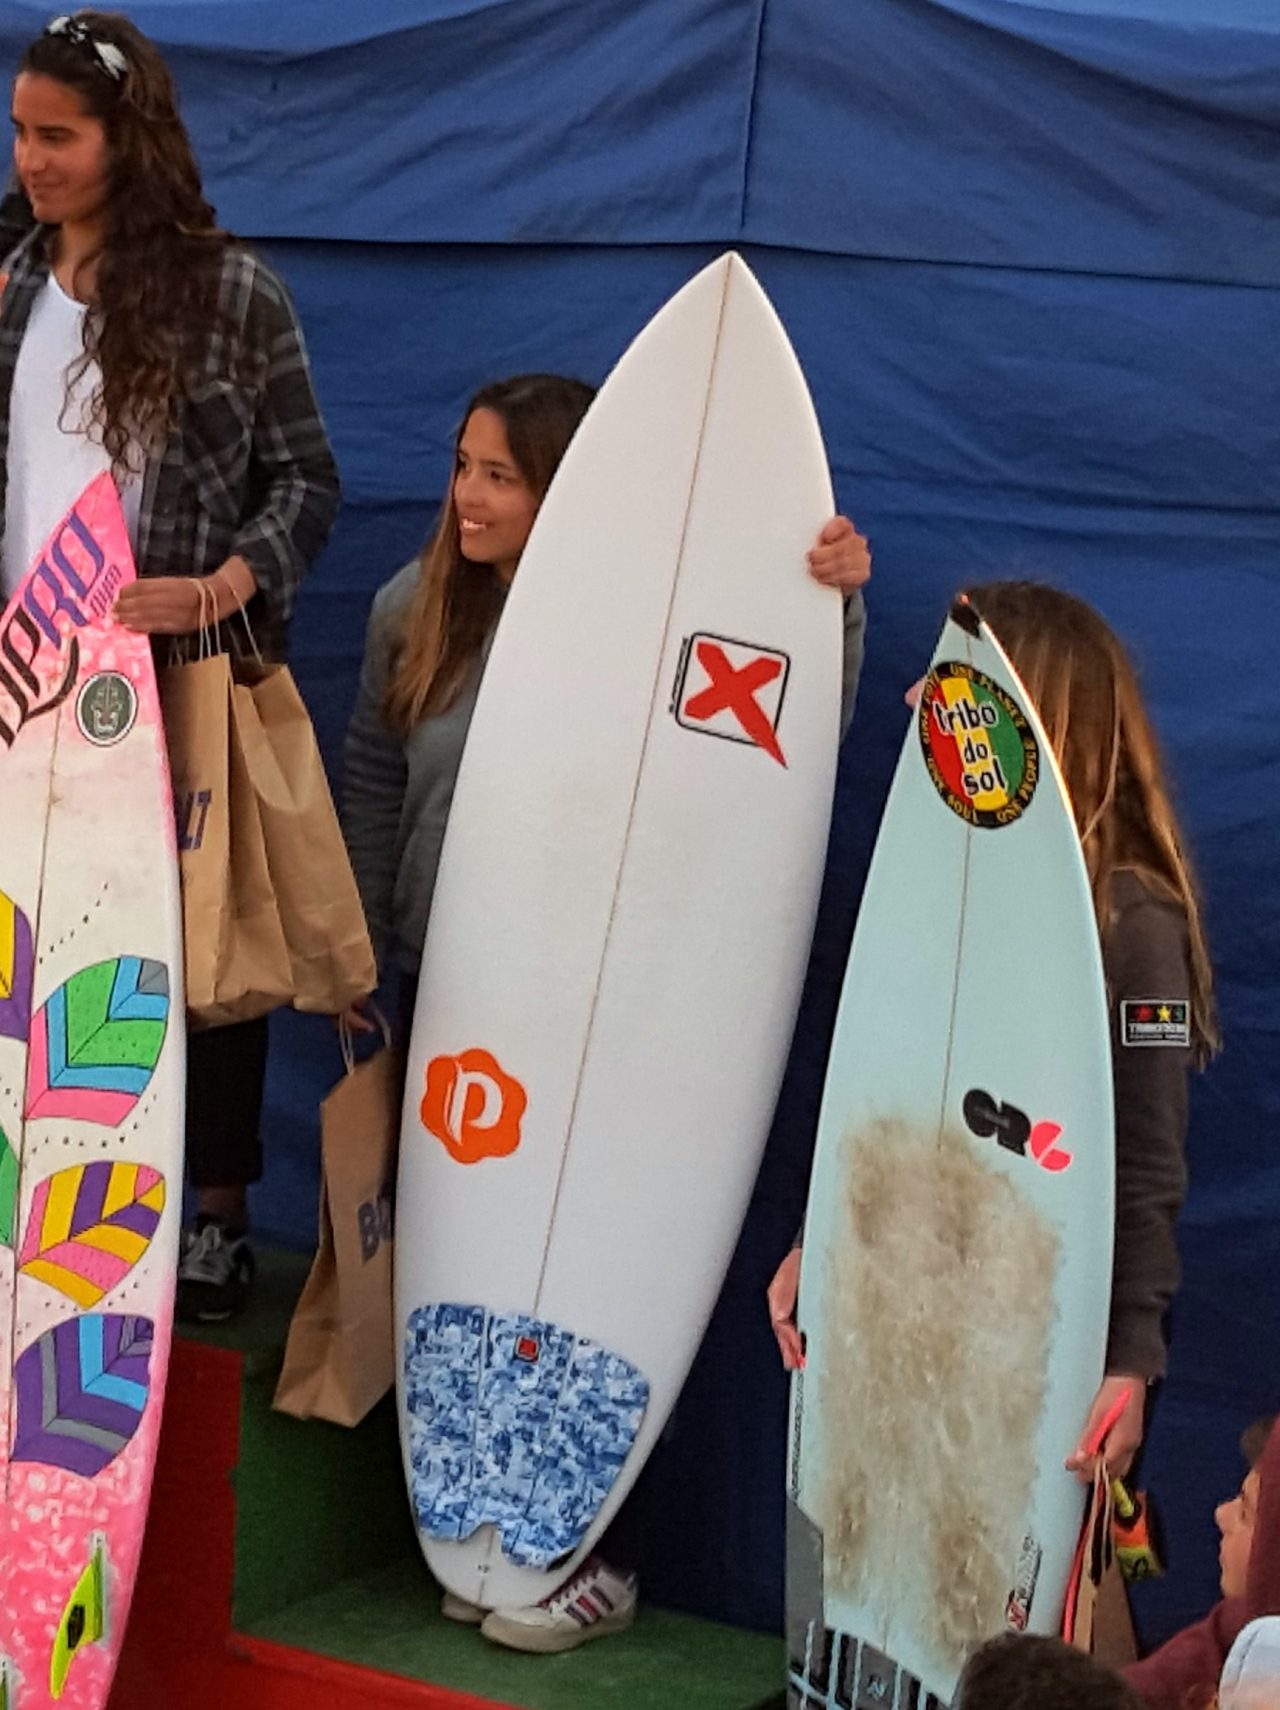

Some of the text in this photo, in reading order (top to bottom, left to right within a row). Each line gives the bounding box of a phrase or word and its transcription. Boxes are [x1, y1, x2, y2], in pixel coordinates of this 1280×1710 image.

[933, 698, 998, 734] tribo
[964, 737, 988, 764] do
[963, 758, 1006, 795] sol
